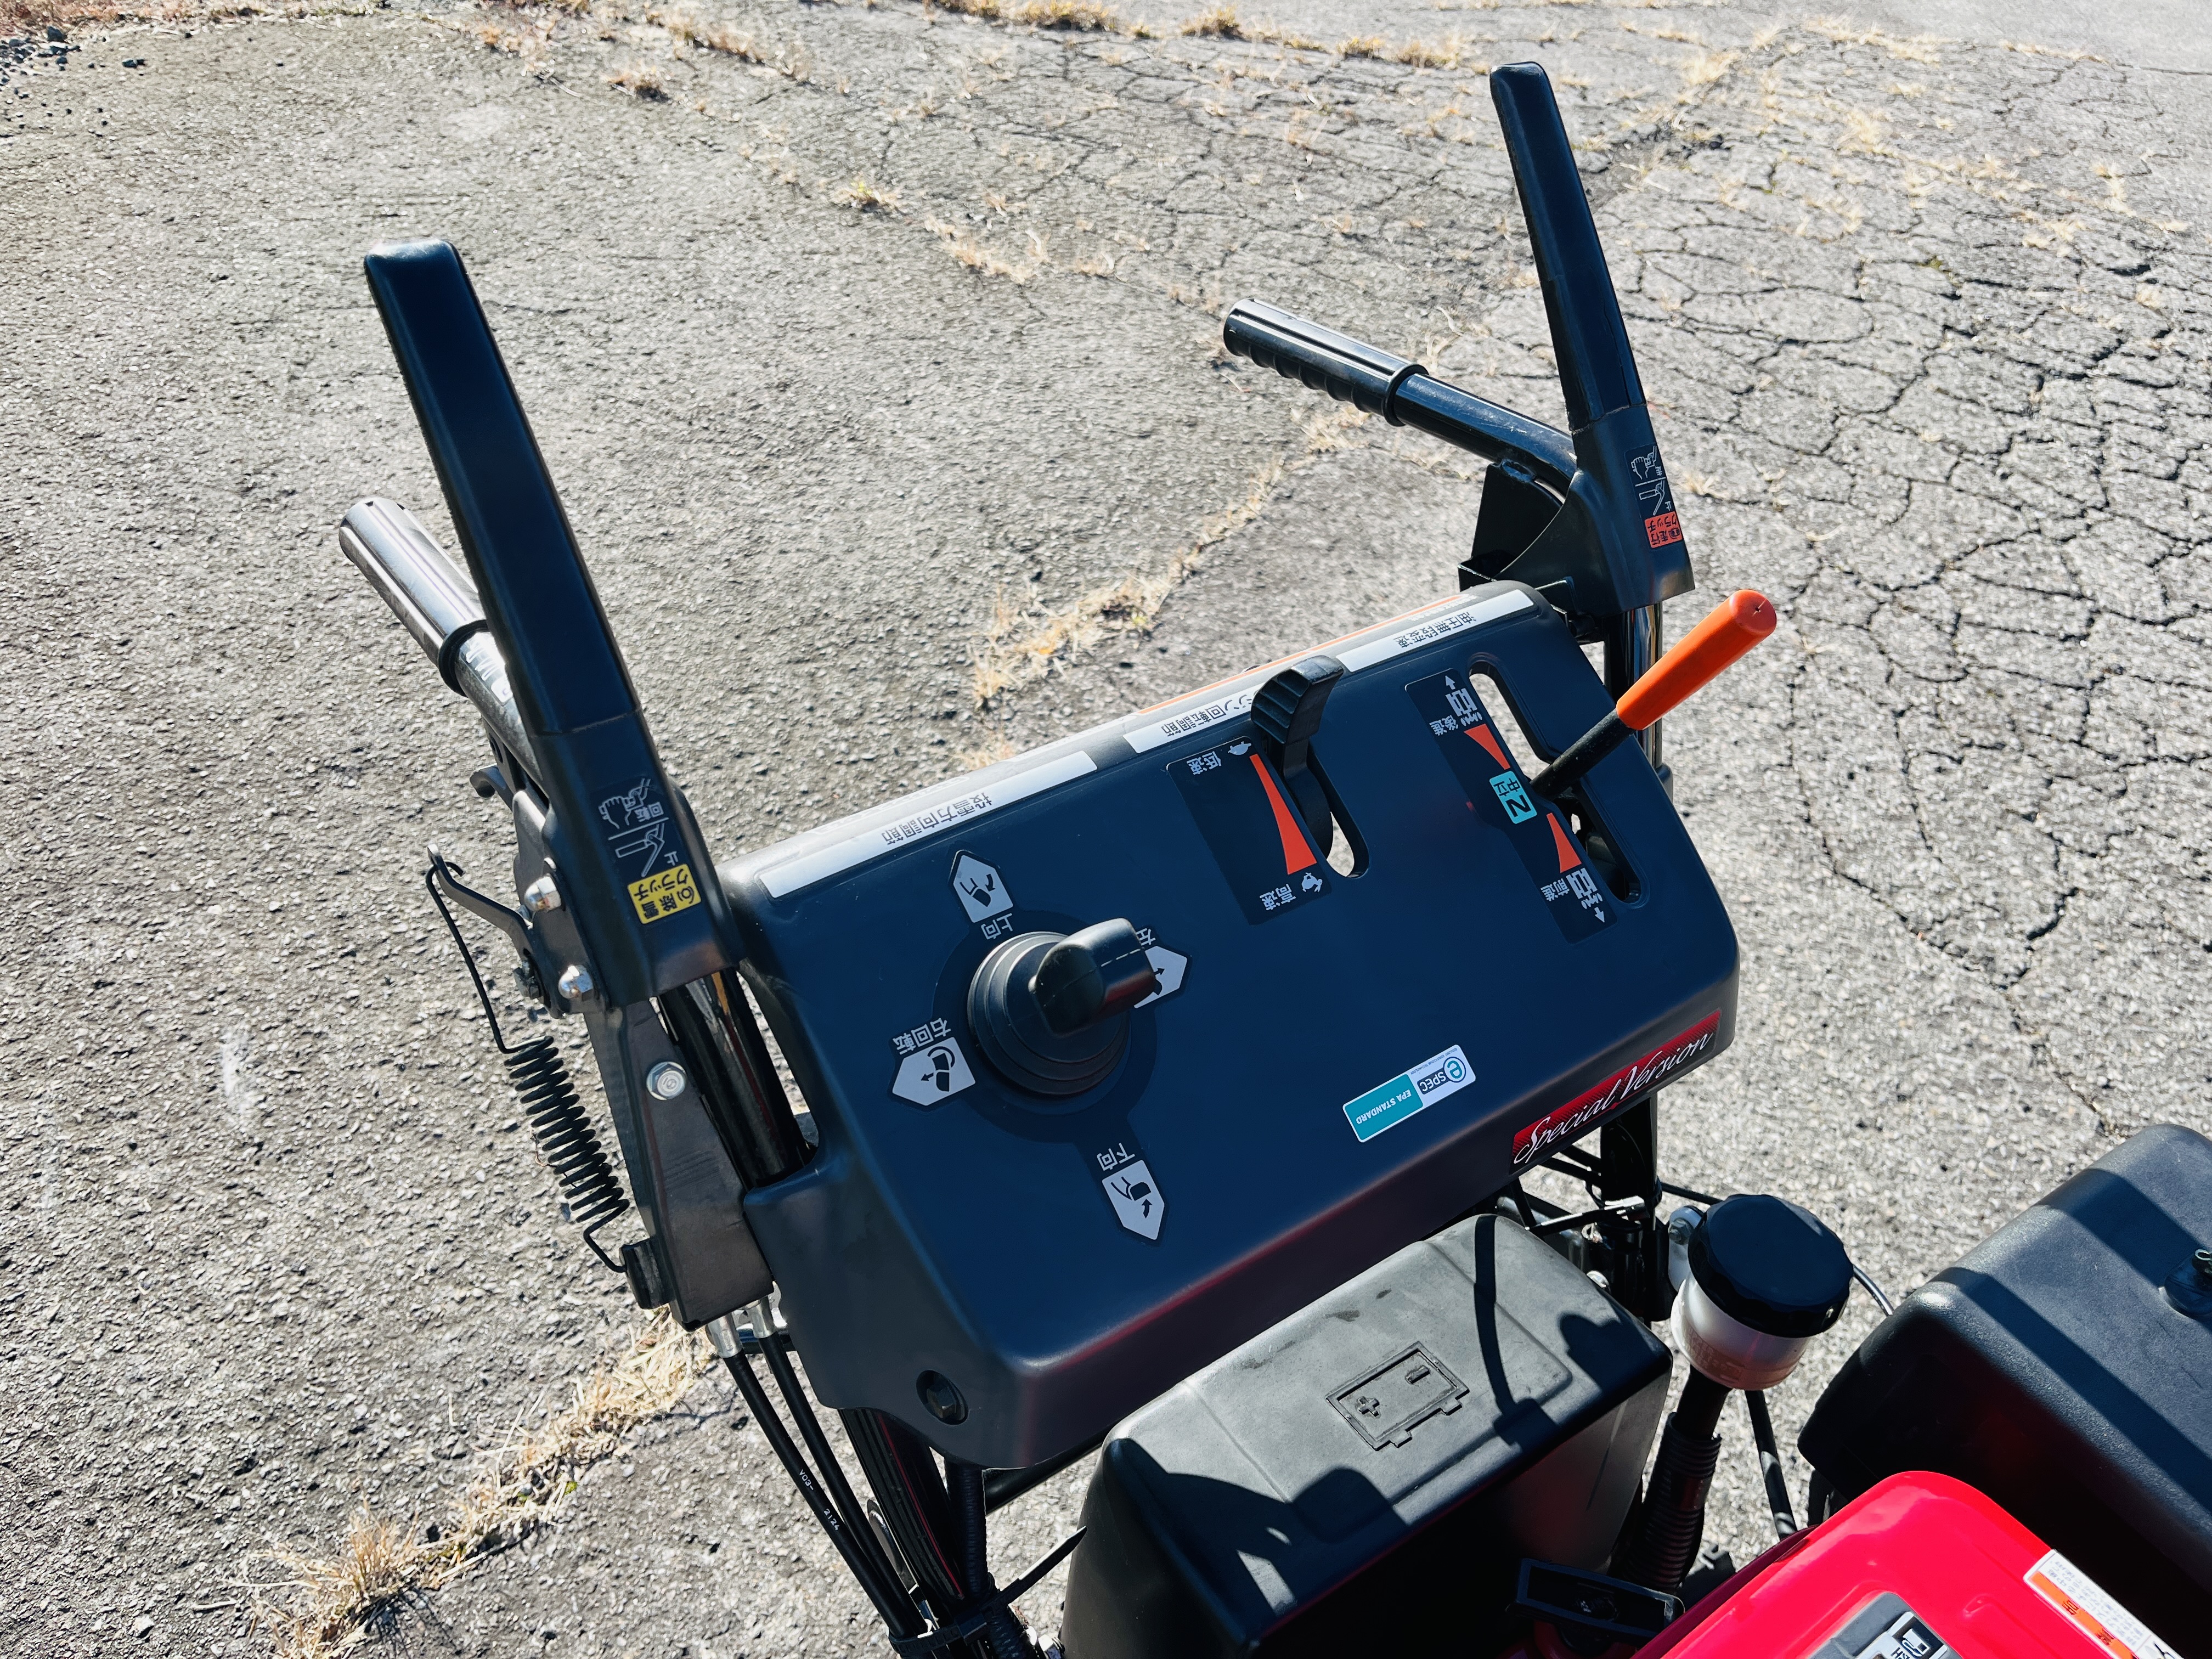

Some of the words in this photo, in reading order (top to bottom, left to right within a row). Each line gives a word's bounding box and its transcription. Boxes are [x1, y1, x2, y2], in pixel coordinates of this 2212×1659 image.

[1664, 500, 1672, 511] 止
[1647, 514, 1678, 533] クラッチ
[1650, 529, 1668, 546] 走行
[1393, 612, 1477, 648] 油圧無段変速
[1161, 690, 1260, 737] ジン回転調節
[1429, 715, 1459, 736] 後進
[1187, 751, 1221, 775] 低速
[1494, 778, 1520, 797] 中立
[634, 801, 664, 822] 回転
[881, 792, 992, 845] 投雪方向調節
[1506, 795, 1531, 817] N
[664, 851, 679, 866] 止
[634, 868, 689, 901] クラッチ
[1541, 878, 1570, 901] 前進
[642, 893, 678, 919] 除雪
[1260, 884, 1296, 911] 高速
[981, 913, 1013, 940] 上向
[893, 1018, 951, 1054] 右回転
[1396, 1089, 1412, 1102] EPA
[1514, 1079, 1622, 1164] Special
[1620, 1032, 1714, 1100] Version
[1356, 1098, 1396, 1125] STANDARD
[1097, 1143, 1135, 1171] 下向
